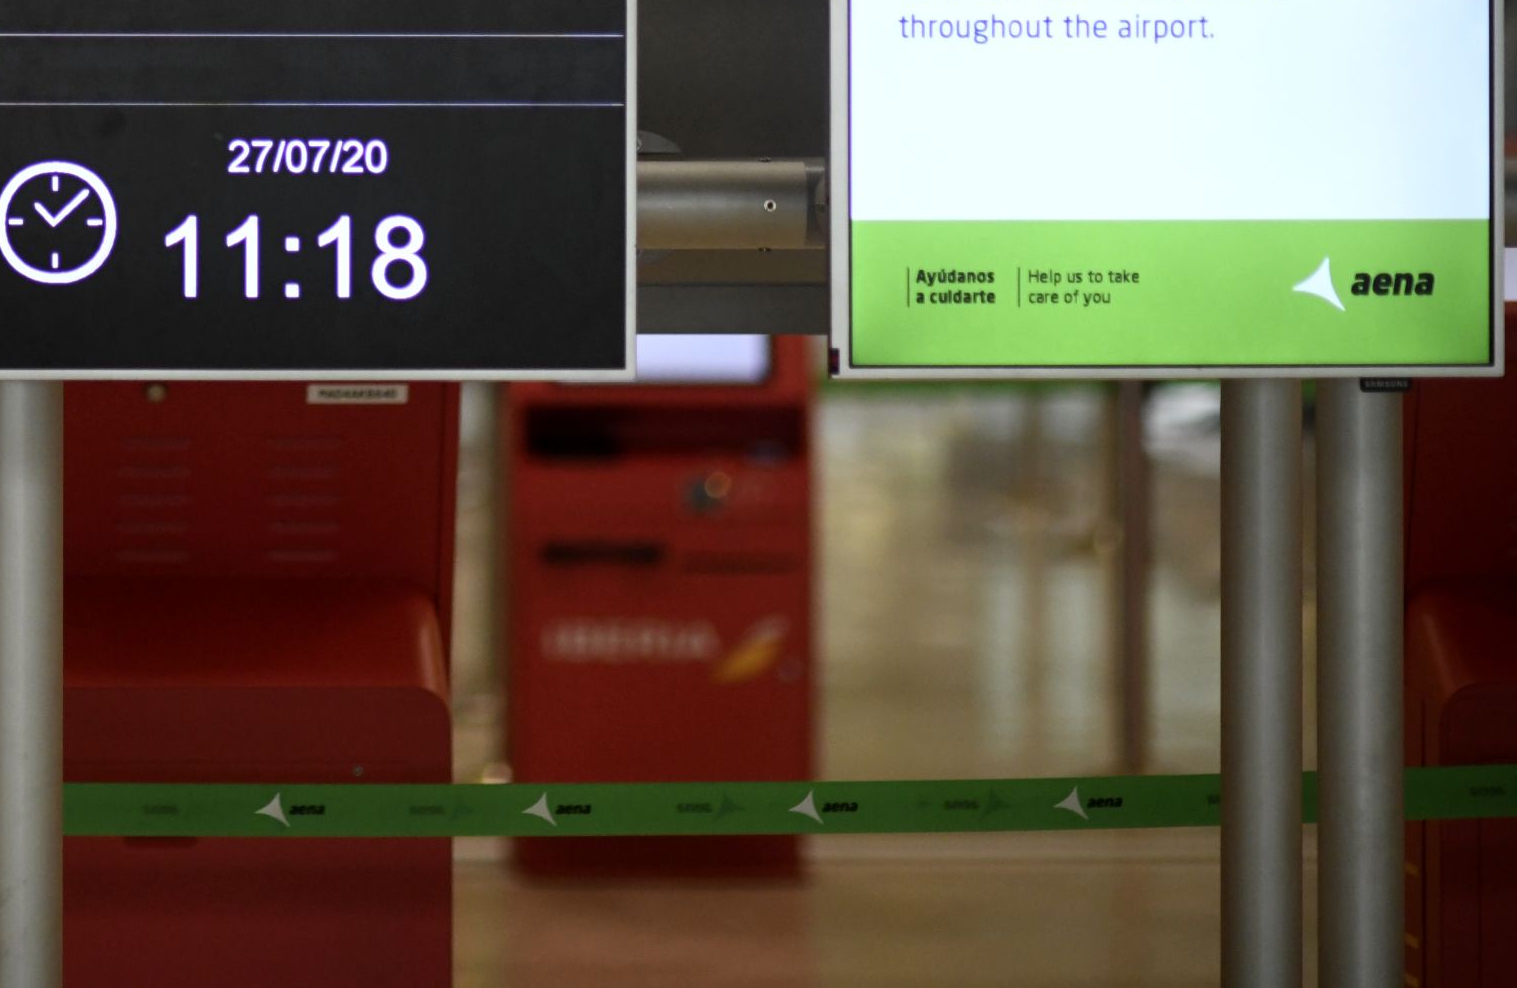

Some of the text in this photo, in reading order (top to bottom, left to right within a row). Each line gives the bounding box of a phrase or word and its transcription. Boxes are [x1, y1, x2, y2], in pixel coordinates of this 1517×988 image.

[898, 14, 1214, 44] throughout the airport.
[228, 140, 387, 173] 27/07/20
[165, 215, 427, 299] 11:18
[917, 270, 994, 286] Ayúdanos
[1029, 272, 1138, 283] Help us to take
[1351, 272, 1435, 296] aena
[917, 291, 994, 303] a cuidarte
[1029, 291, 1109, 306] care of you
[822, 800, 859, 812] aena
[1087, 796, 1123, 808] aena
[289, 803, 325, 815] aena
[555, 803, 592, 815] aena
